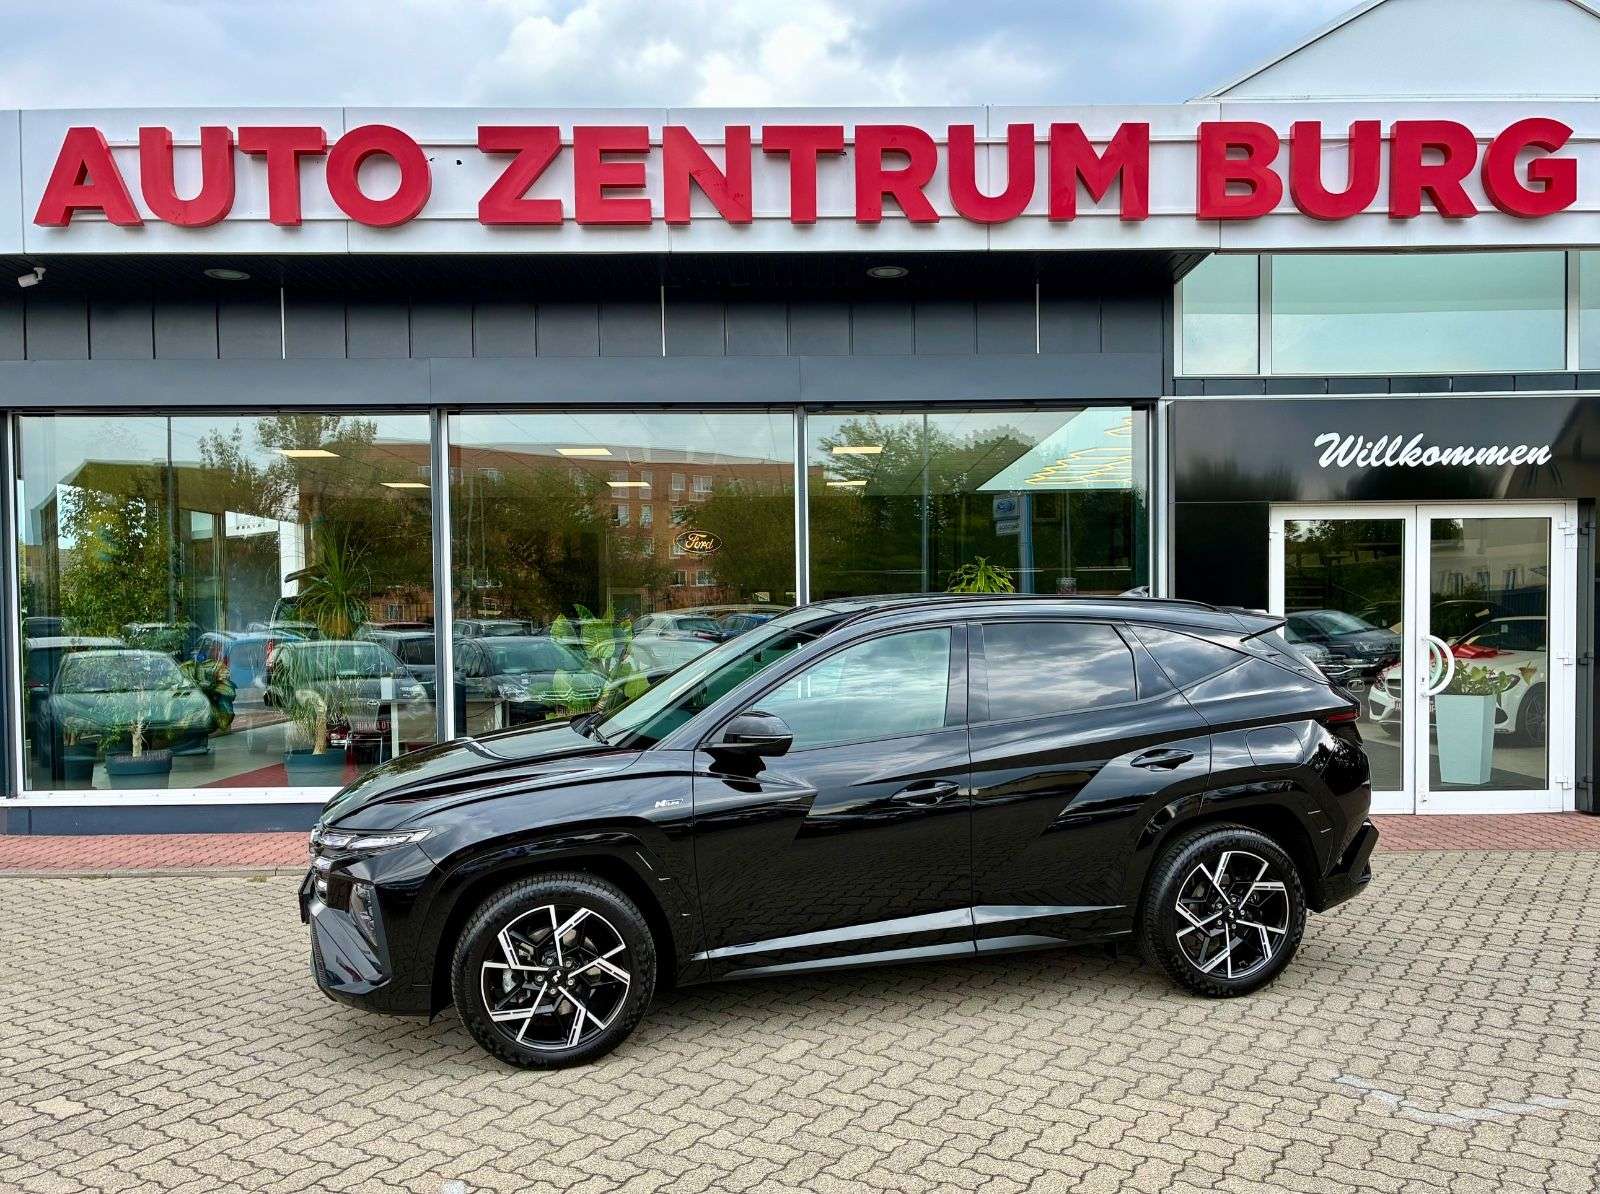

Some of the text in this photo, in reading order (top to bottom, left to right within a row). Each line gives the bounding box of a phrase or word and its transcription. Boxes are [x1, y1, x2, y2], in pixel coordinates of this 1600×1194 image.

[33, 117, 1578, 228] AUTO ZENTRUM BURG
[1313, 432, 1552, 468] Willkommen
[685, 532, 714, 549] Ford
